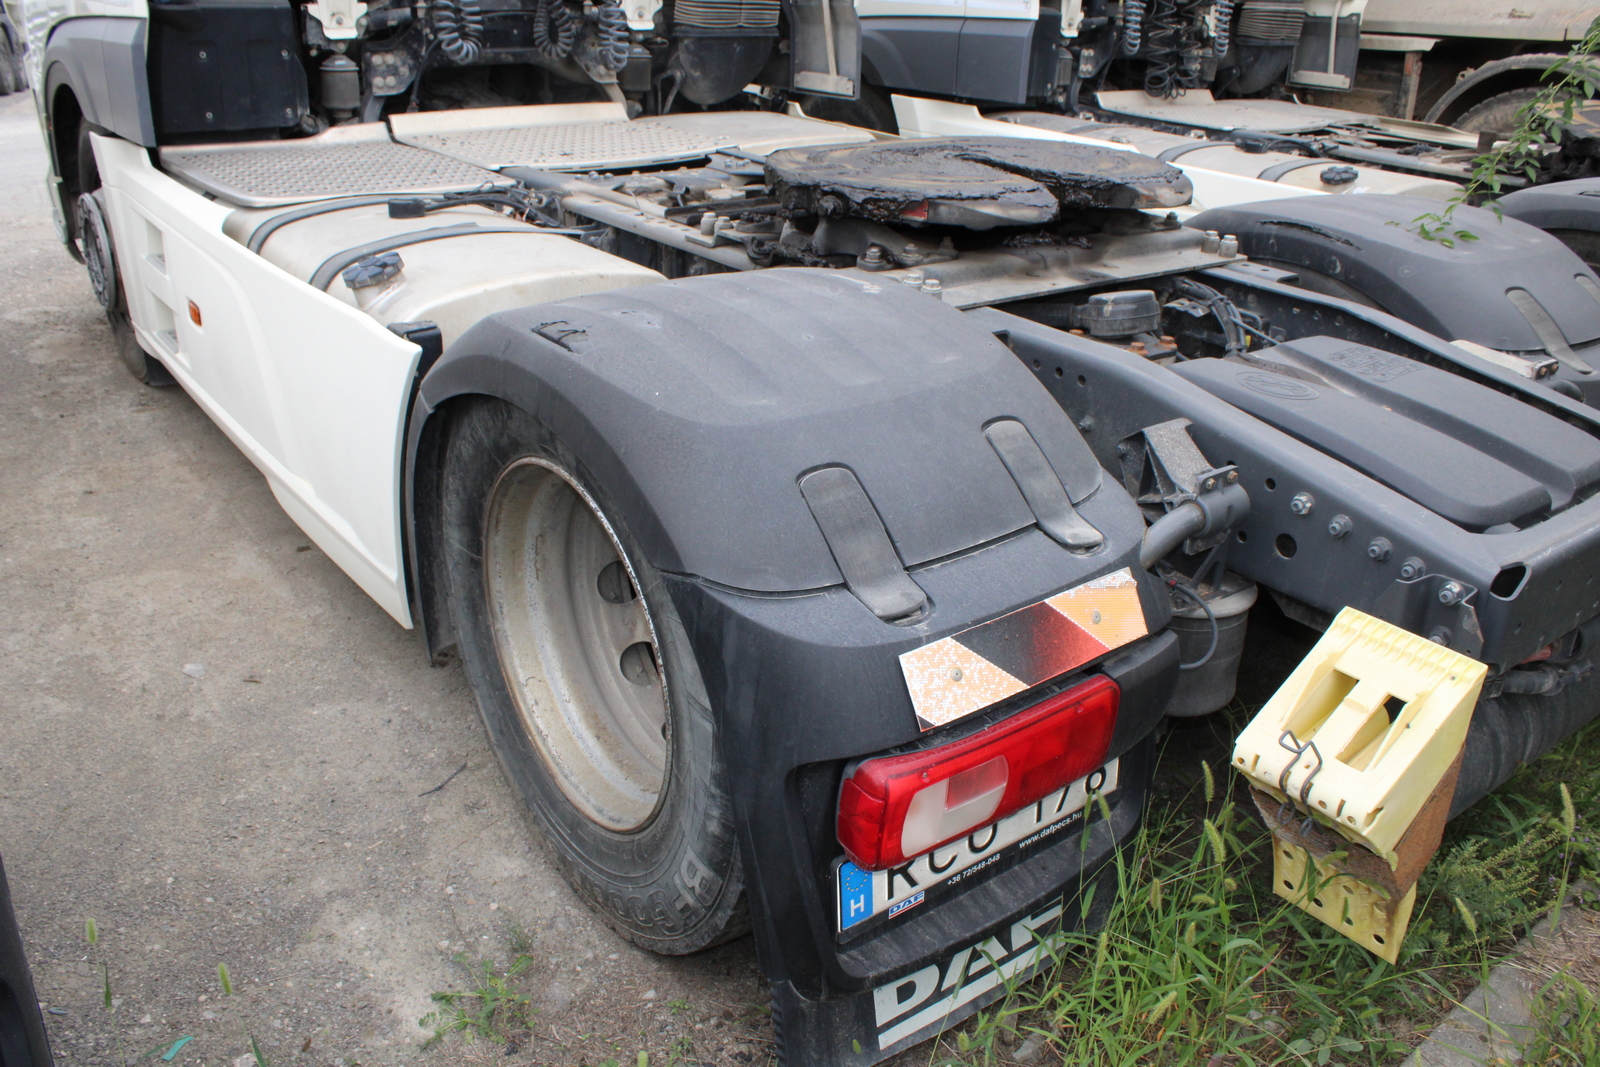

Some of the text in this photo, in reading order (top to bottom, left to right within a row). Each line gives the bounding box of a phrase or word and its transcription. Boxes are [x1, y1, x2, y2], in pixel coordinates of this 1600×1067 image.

[1018, 811, 1083, 849] www.dafpecs.hu
[948, 873, 962, 886] +36
[849, 894, 865, 919] H
[890, 892, 924, 915] DAF
[873, 895, 1064, 1028] DAF
